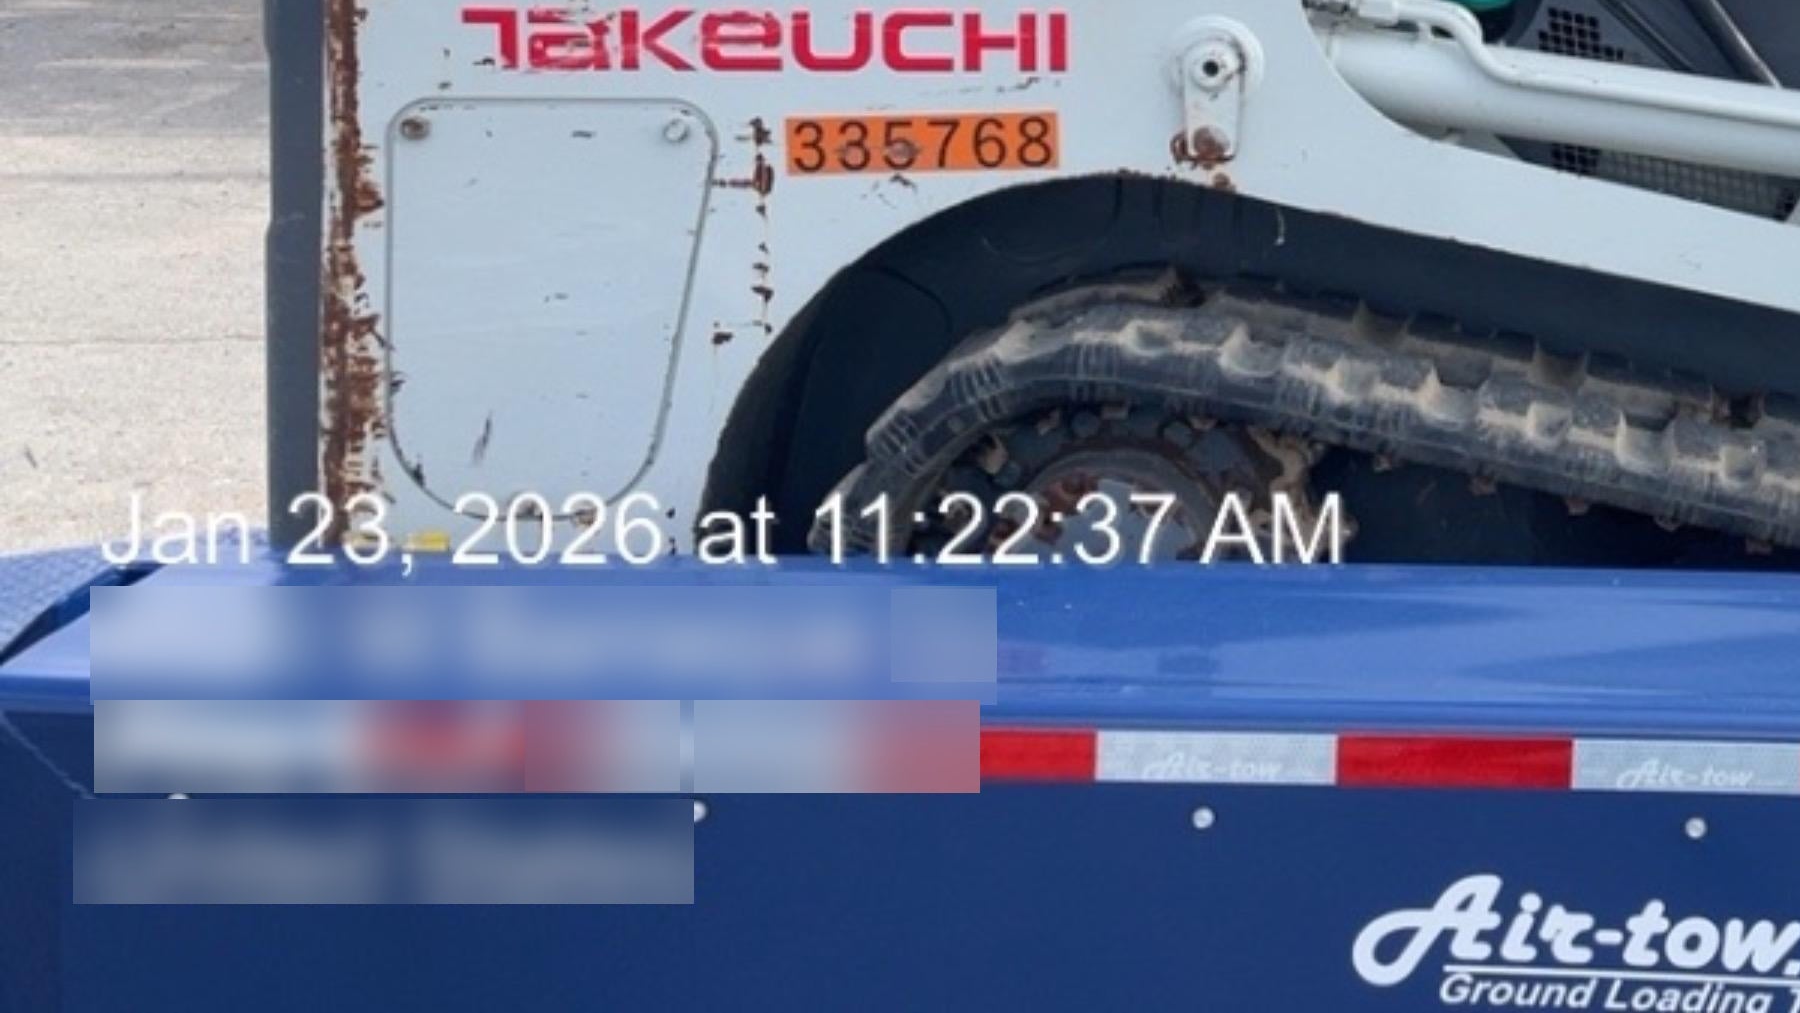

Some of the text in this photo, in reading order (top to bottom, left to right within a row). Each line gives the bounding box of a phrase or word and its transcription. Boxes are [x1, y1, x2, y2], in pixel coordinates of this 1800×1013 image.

[791, 115, 1054, 173] 335768
[1142, 751, 1283, 781] Air-tow
[1615, 756, 1755, 789] Air-tow
[1439, 972, 1598, 1007] Ground
[1604, 976, 1774, 1013] Loading
